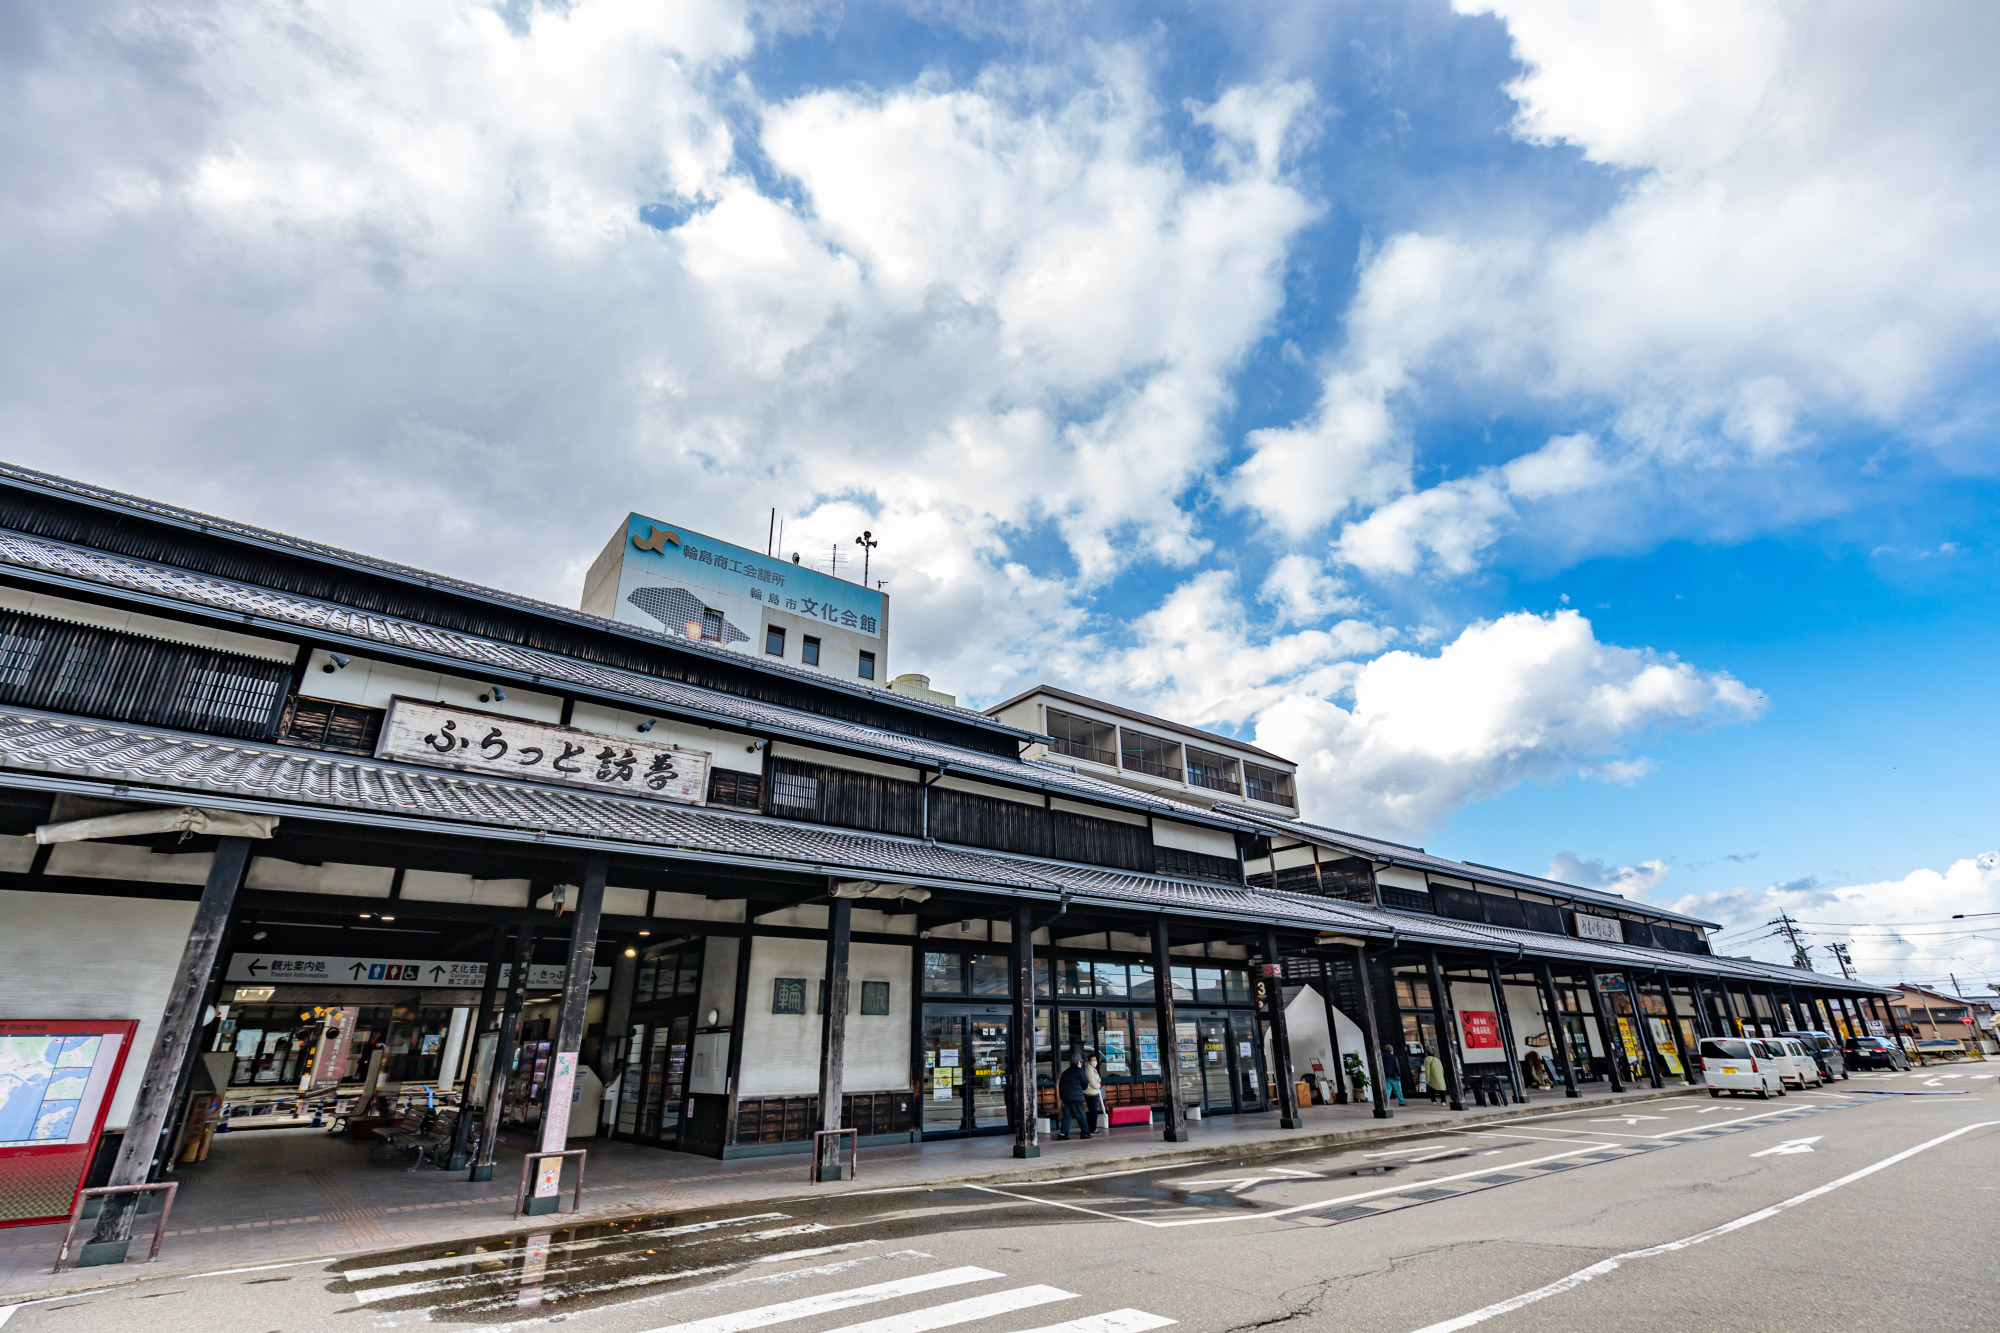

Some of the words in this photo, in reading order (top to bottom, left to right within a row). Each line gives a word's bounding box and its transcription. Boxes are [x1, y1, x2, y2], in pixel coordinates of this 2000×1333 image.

[682, 544, 786, 588] 輪島商工会議所
[750, 587, 877, 635] 輪島市文化会館
[425, 720, 679, 790] ふらっと訪夢
[271, 960, 325, 972] 観光案内処
[1264, 965, 1272, 974] 3
[1273, 965, 1280, 974] 3
[778, 983, 802, 1010] 輪
[1257, 982, 1266, 995] 3
